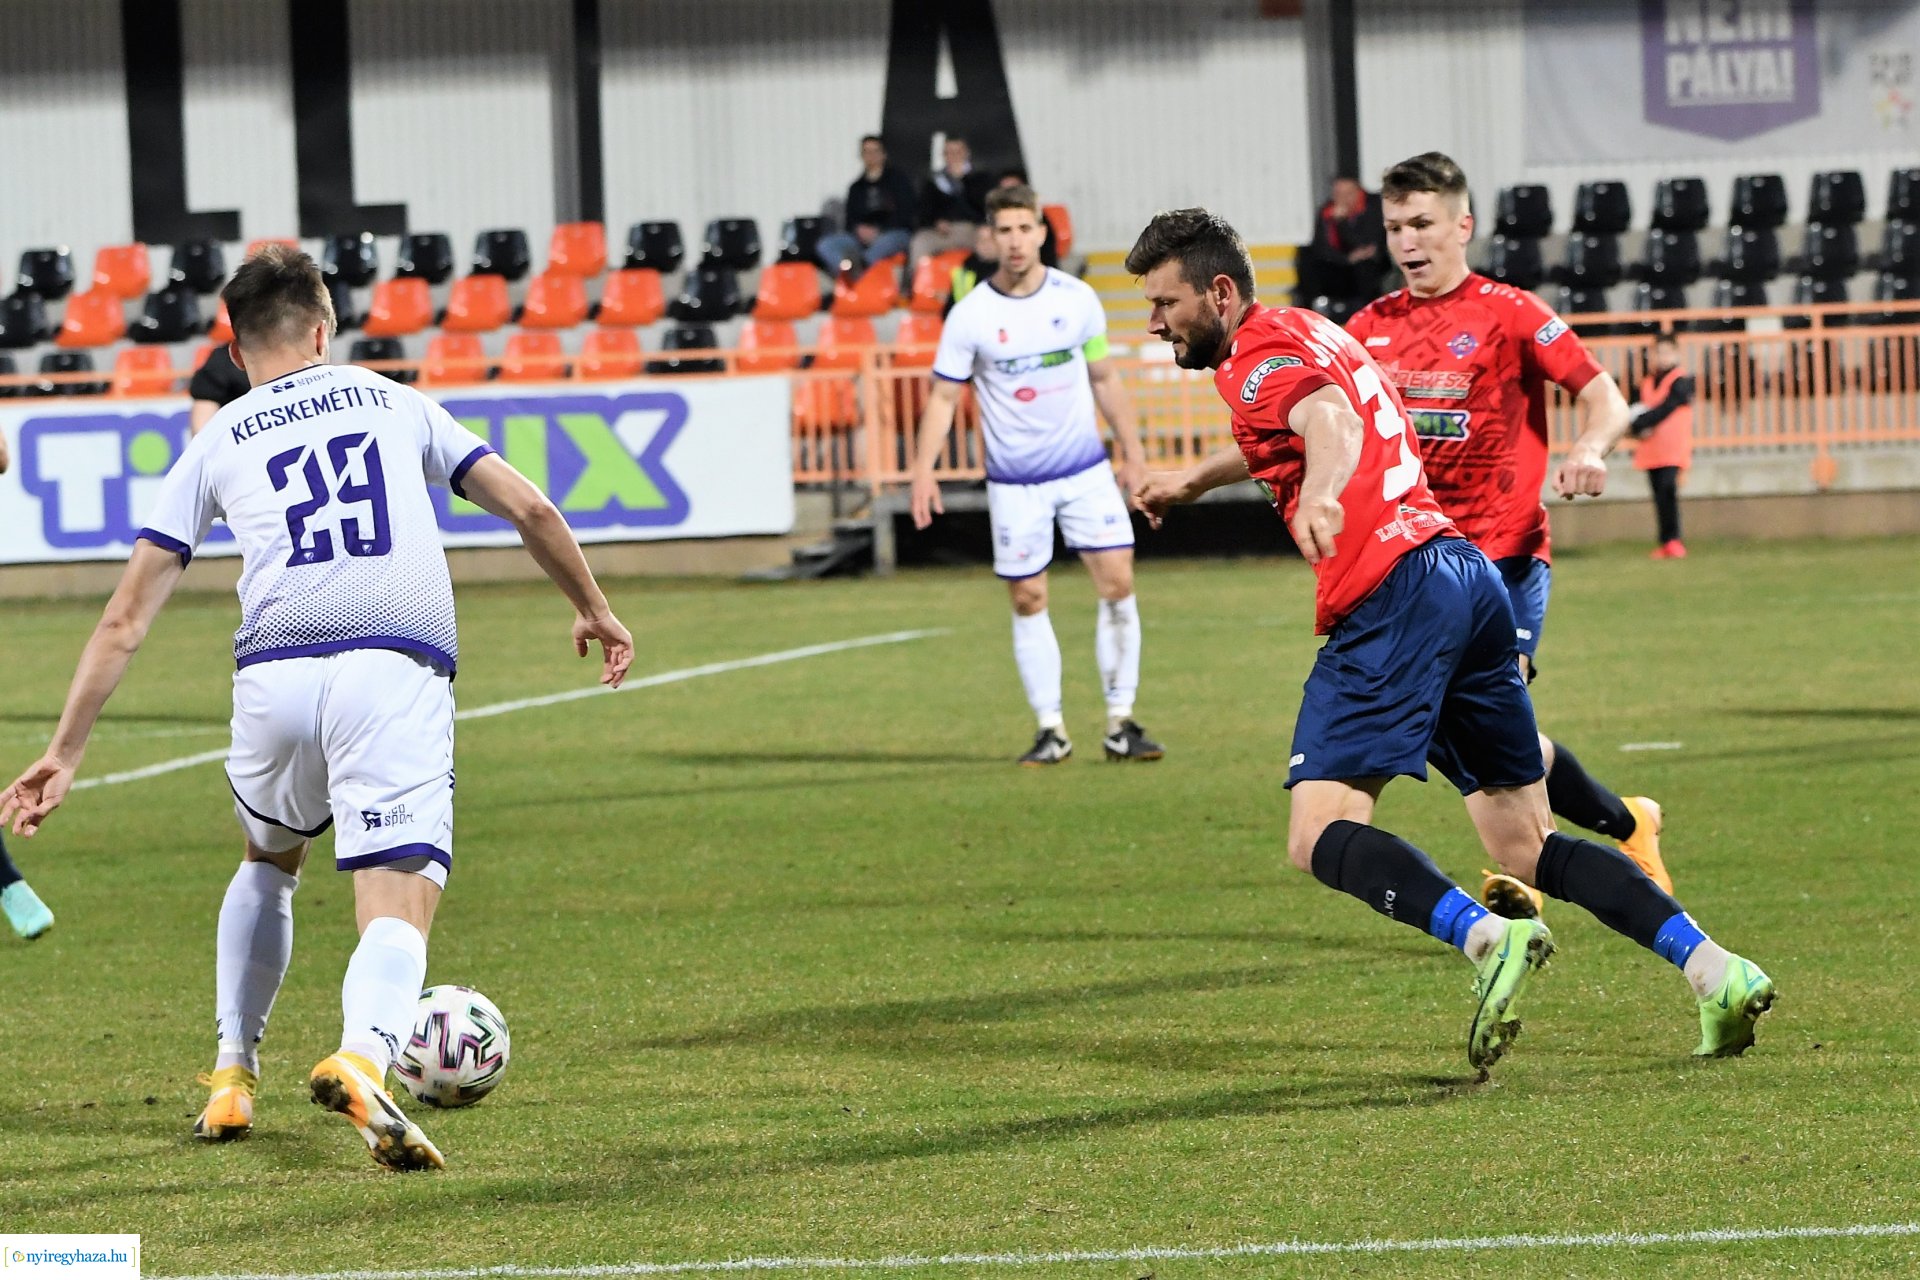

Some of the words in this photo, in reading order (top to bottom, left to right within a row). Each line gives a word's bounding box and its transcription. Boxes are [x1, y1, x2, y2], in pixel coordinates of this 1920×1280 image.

[231, 386, 363, 446] KECSKEMÉTI
[365, 387, 394, 411] TE
[266, 431, 392, 568] 29
